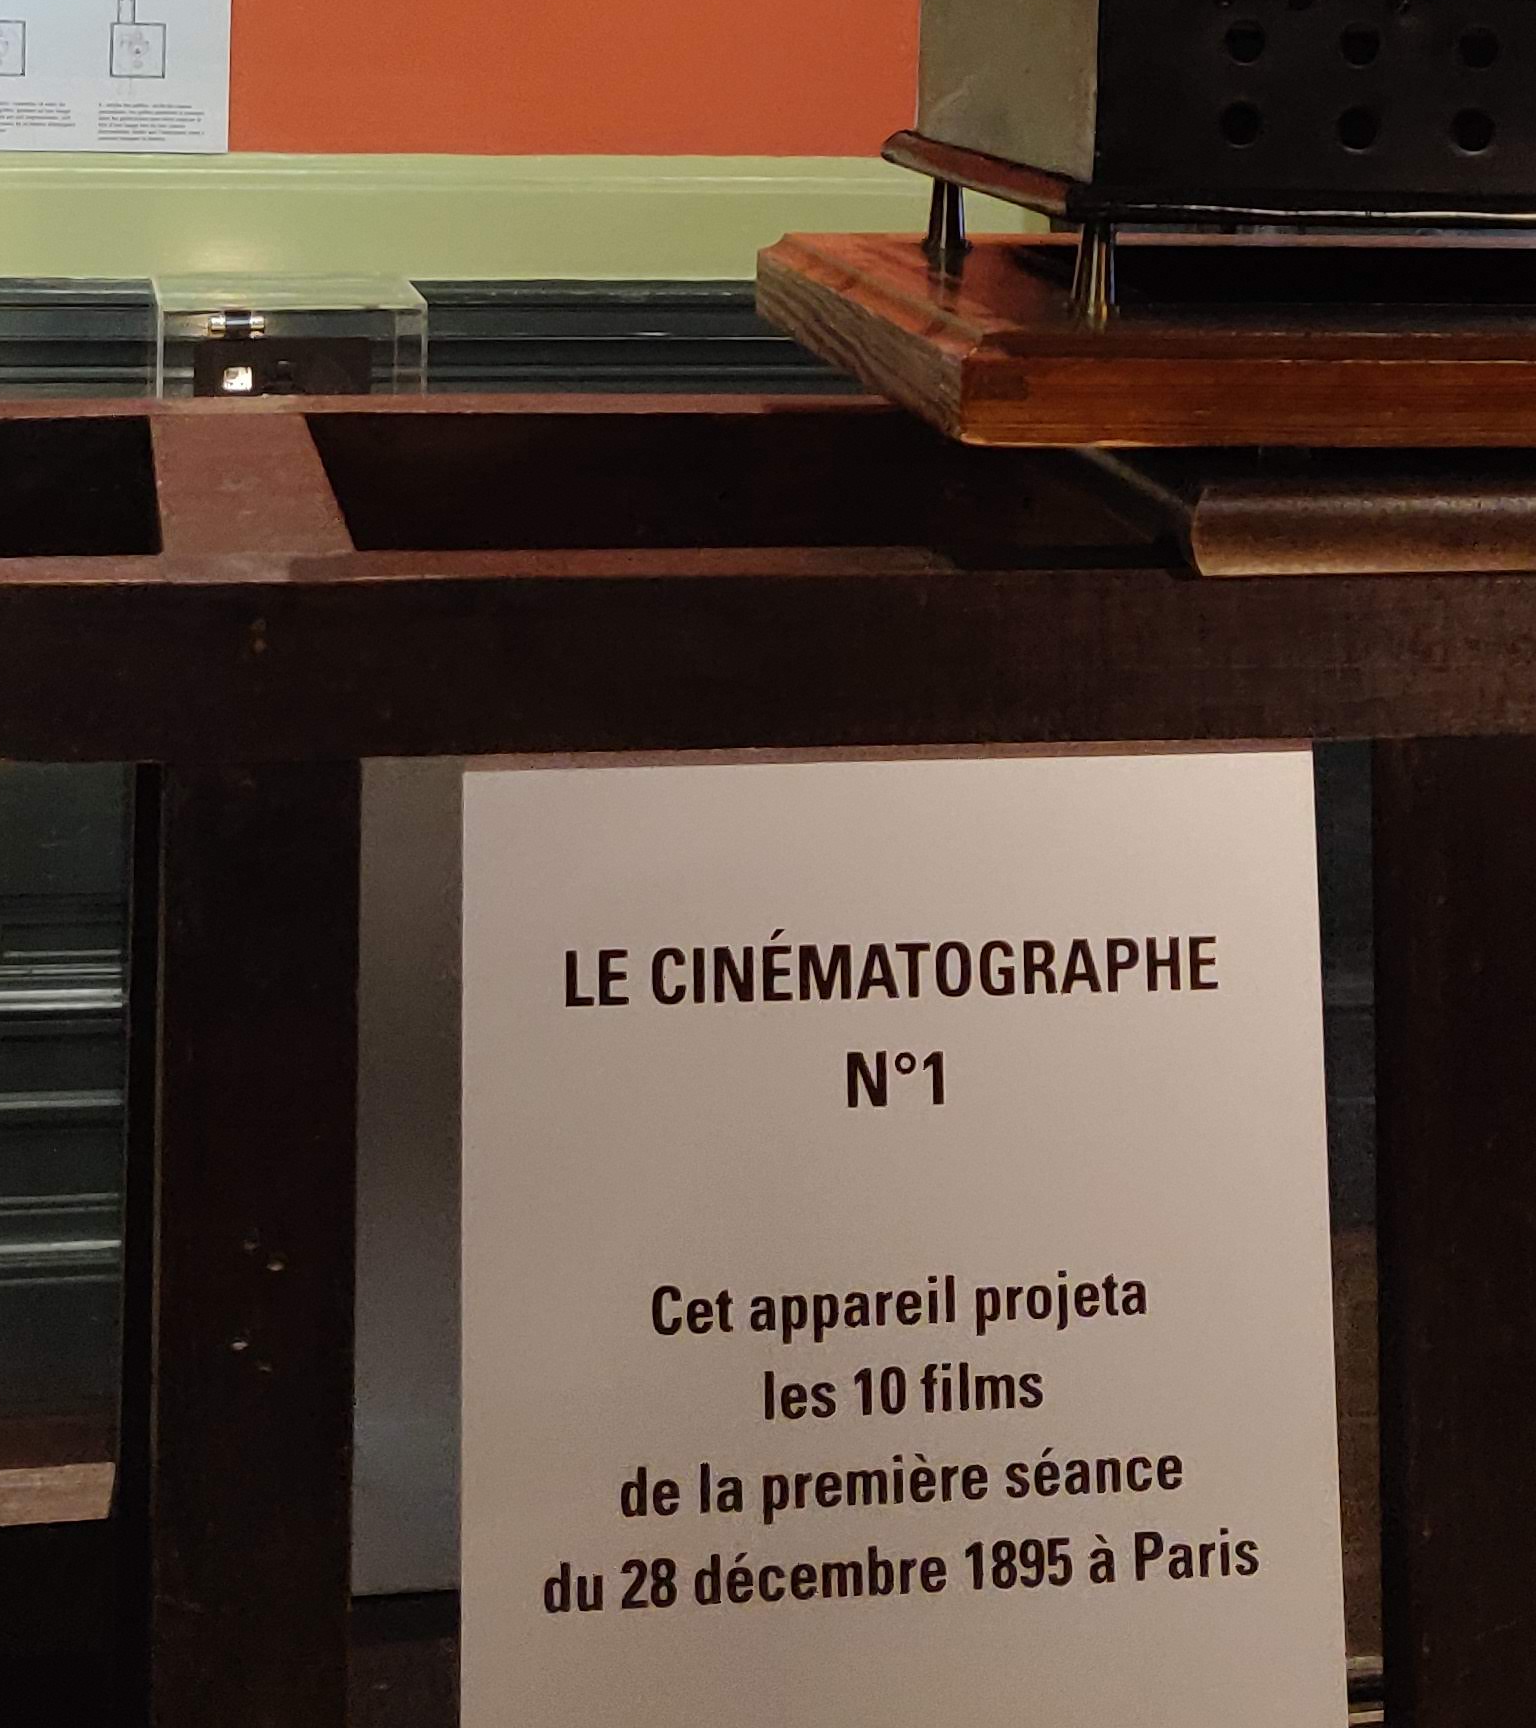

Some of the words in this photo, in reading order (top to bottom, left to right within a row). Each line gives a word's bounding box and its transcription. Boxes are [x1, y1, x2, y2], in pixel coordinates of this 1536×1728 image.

[565, 948, 630, 1008] LE
[651, 928, 1219, 1007] CINÉMATOGRAPHE
[846, 1050, 945, 1109] N°1
[651, 1285, 734, 1336] Cet
[749, 1274, 956, 1345] appareil
[975, 1269, 1147, 1337] projeta
[763, 1370, 837, 1421] les
[853, 1365, 907, 1417] 10
[919, 1361, 1044, 1414] films
[620, 1465, 681, 1518] de
[699, 1461, 744, 1514] la
[762, 1452, 989, 1526] première
[1005, 1446, 1183, 1499] séance
[543, 1560, 604, 1614] du
[619, 1557, 678, 1610] 28
[694, 1545, 947, 1606] décembre
[964, 1537, 1073, 1591] 1895
[1089, 1533, 1116, 1585] à
[1134, 1527, 1260, 1582] Paris
